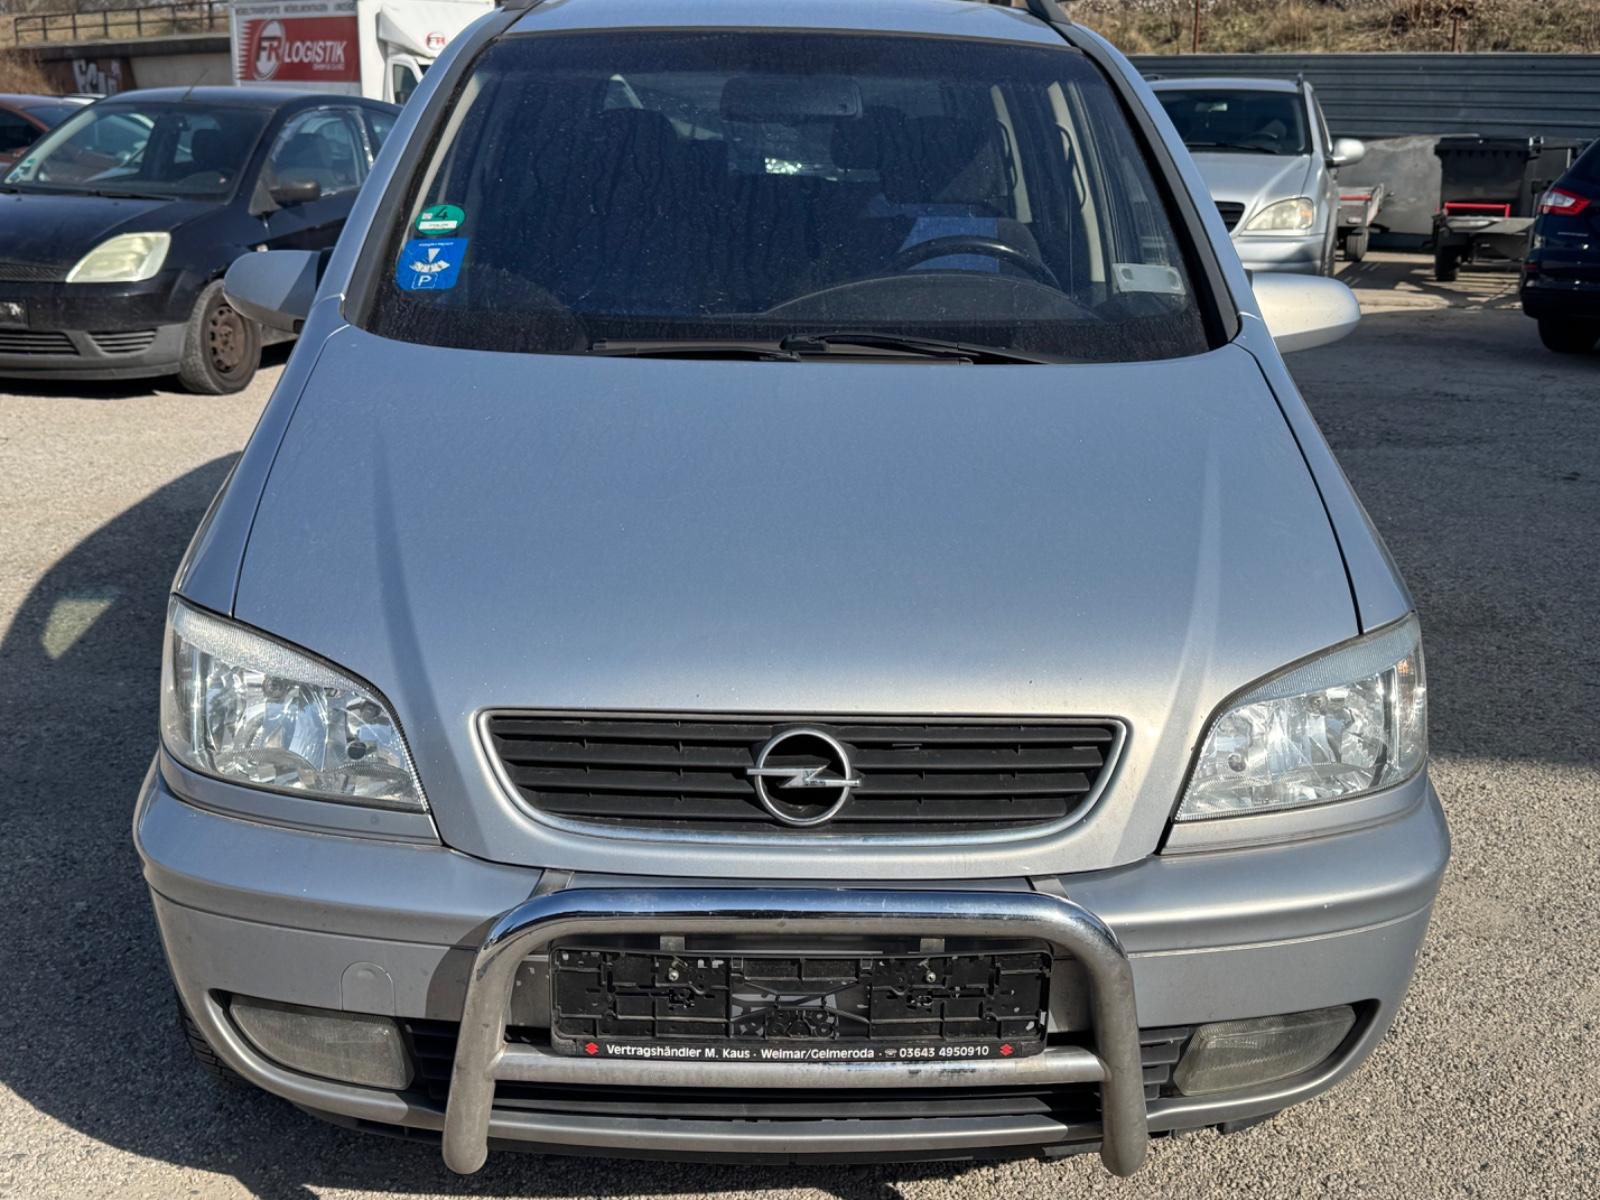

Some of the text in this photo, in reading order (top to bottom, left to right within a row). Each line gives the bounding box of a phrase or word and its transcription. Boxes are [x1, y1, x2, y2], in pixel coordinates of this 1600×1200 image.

[256, 37, 348, 63] FR LOGISTIK
[434, 206, 448, 220] 4
[418, 275, 432, 287] P
[606, 1044, 989, 1060] Vertragshändler M. Kaus Weimar/Gelmeroda 03643 4950910
